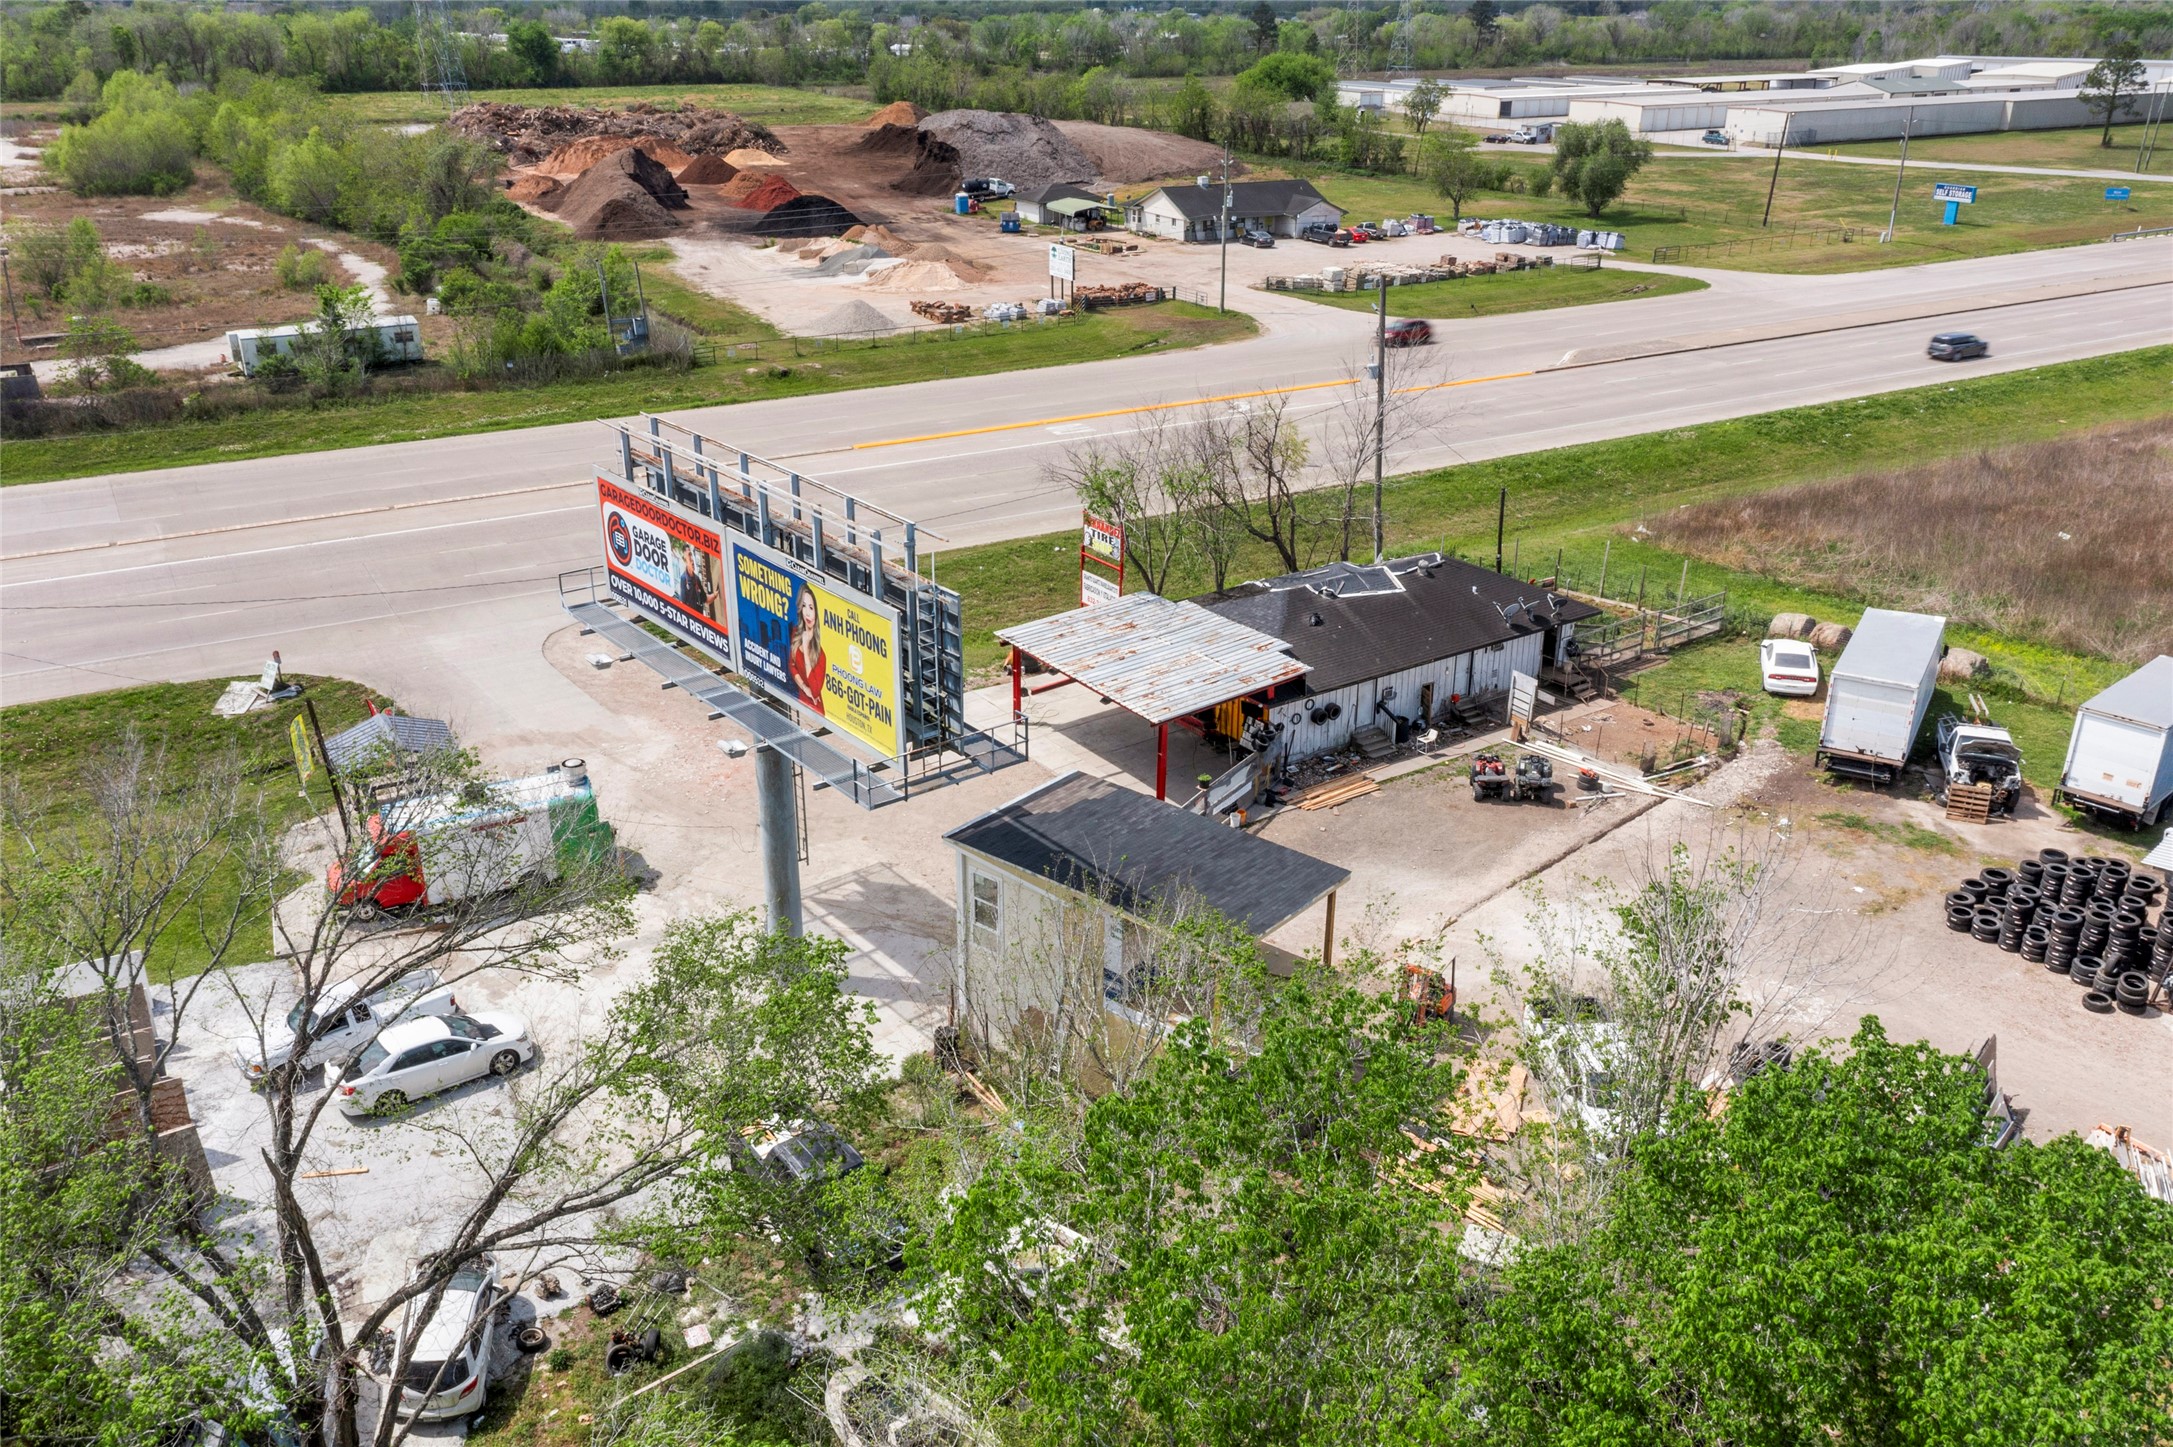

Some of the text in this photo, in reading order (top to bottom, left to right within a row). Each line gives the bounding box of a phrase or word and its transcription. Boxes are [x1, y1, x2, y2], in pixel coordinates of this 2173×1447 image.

[1936, 188, 1972, 199] SELF STORAGE
[600, 483, 720, 554] GARAGEDOORDOCTOR.BIZ
[632, 525, 667, 553] GARAGE
[1091, 528, 1114, 545] TIRE
[633, 538, 669, 572] DOOR
[635, 558, 671, 587] DOCTOR
[737, 553, 792, 597] SOMETHING
[610, 575, 729, 653] OVER 10,000 5-STAR REVIEWS
[739, 574, 789, 620] WRONG?
[846, 608, 860, 624] CALL
[823, 608, 887, 659] ANH PHOONG
[744, 637, 781, 667] ACCIDENT AND
[745, 649, 787, 683] INJURY LAWYERS
[832, 664, 882, 699] PHOONG LAW
[825, 673, 892, 728] 866-GOT-PAIN
